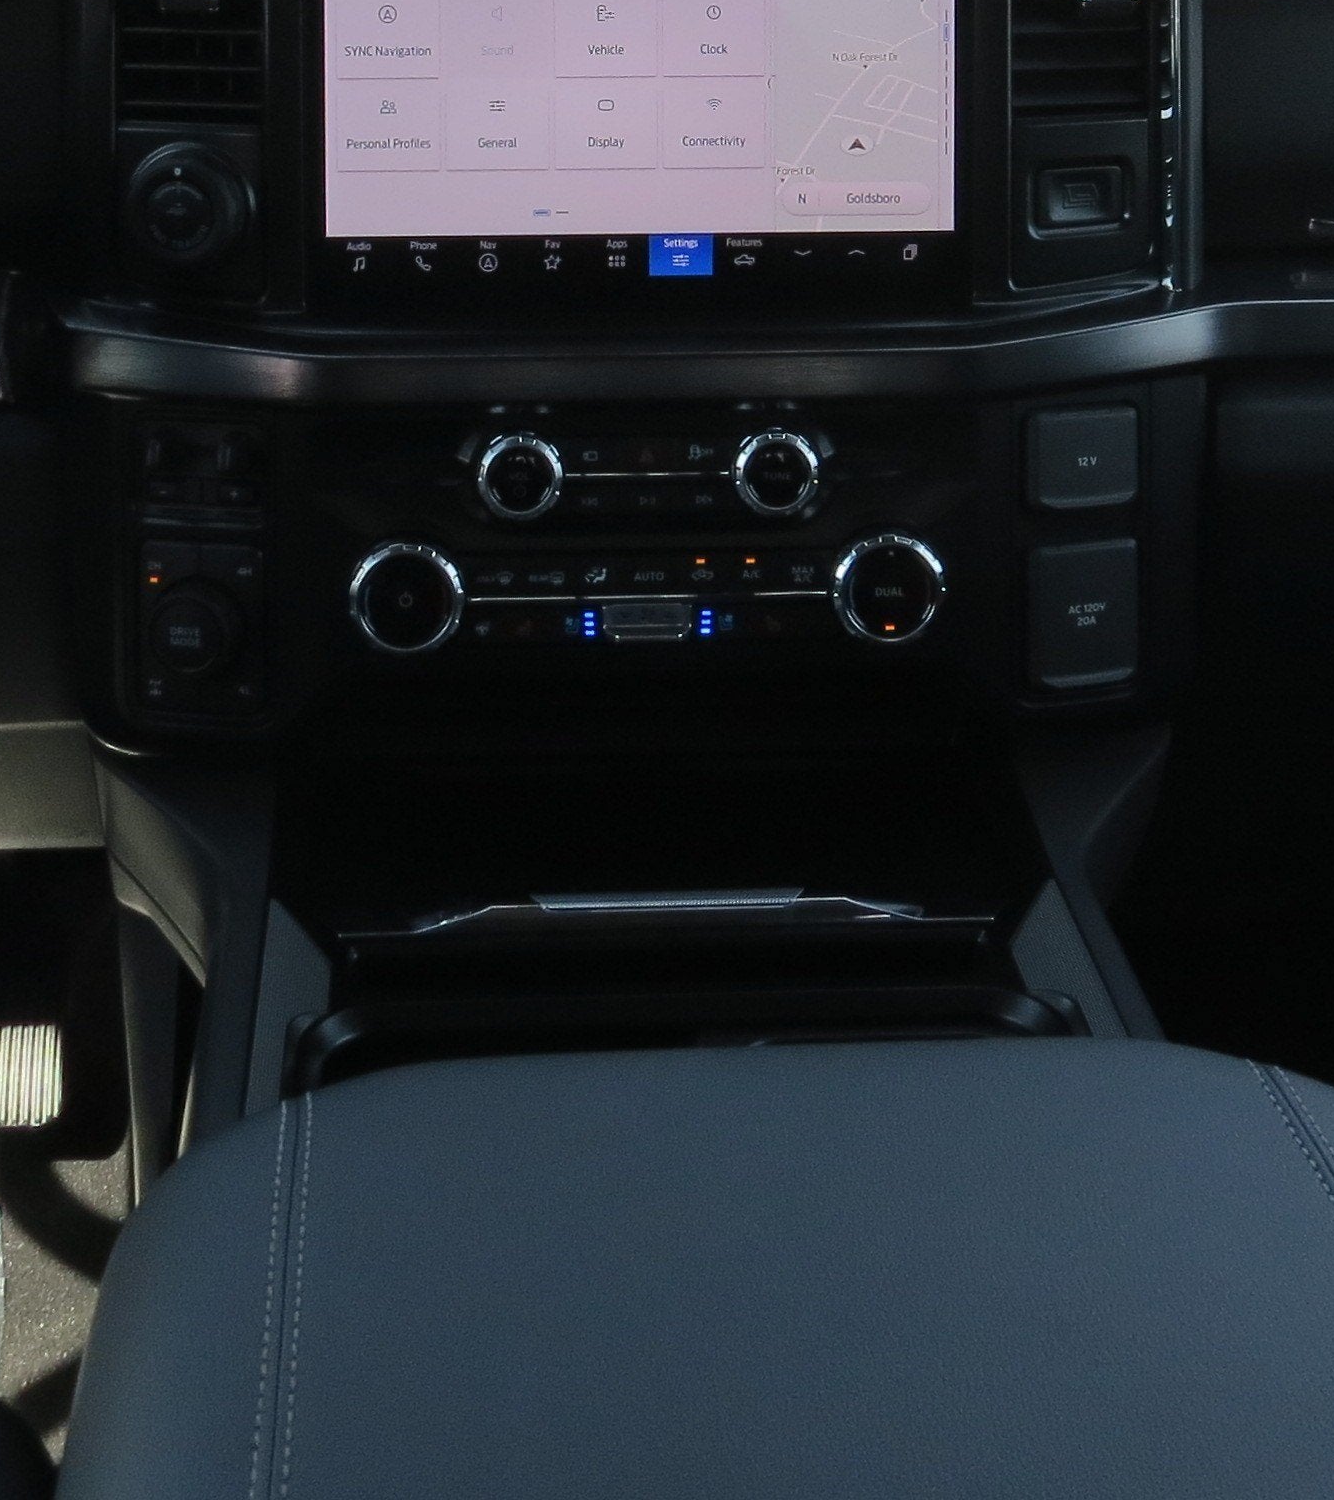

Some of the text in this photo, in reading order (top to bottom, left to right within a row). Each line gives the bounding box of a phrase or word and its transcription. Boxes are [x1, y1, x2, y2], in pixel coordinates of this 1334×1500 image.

[344, 45, 432, 58] SYNC Navigation
[481, 45, 514, 56] Sound
[588, 44, 625, 56] Vehicle
[700, 43, 728, 55] Clock
[840, 52, 857, 61] Oak
[859, 52, 887, 61] Forest
[346, 137, 431, 150] Personal Profiles
[478, 137, 517, 149] General
[588, 136, 625, 150] Display
[682, 135, 746, 149] Connectivity
[798, 192, 901, 205] N Goldsboro
[347, 241, 372, 252] Audio
[410, 240, 438, 251] Phone
[480, 240, 497, 250] Nav
[545, 240, 561, 249] Fav
[606, 239, 628, 251] Apps
[664, 238, 698, 250] Settings
[727, 238, 763, 248] Features
[1078, 456, 1088, 466] 12
[634, 571, 665, 582] AUTO
[875, 587, 904, 597] DUAL
[1068, 604, 1082, 614] AC
[1077, 615, 1097, 626] 20A
